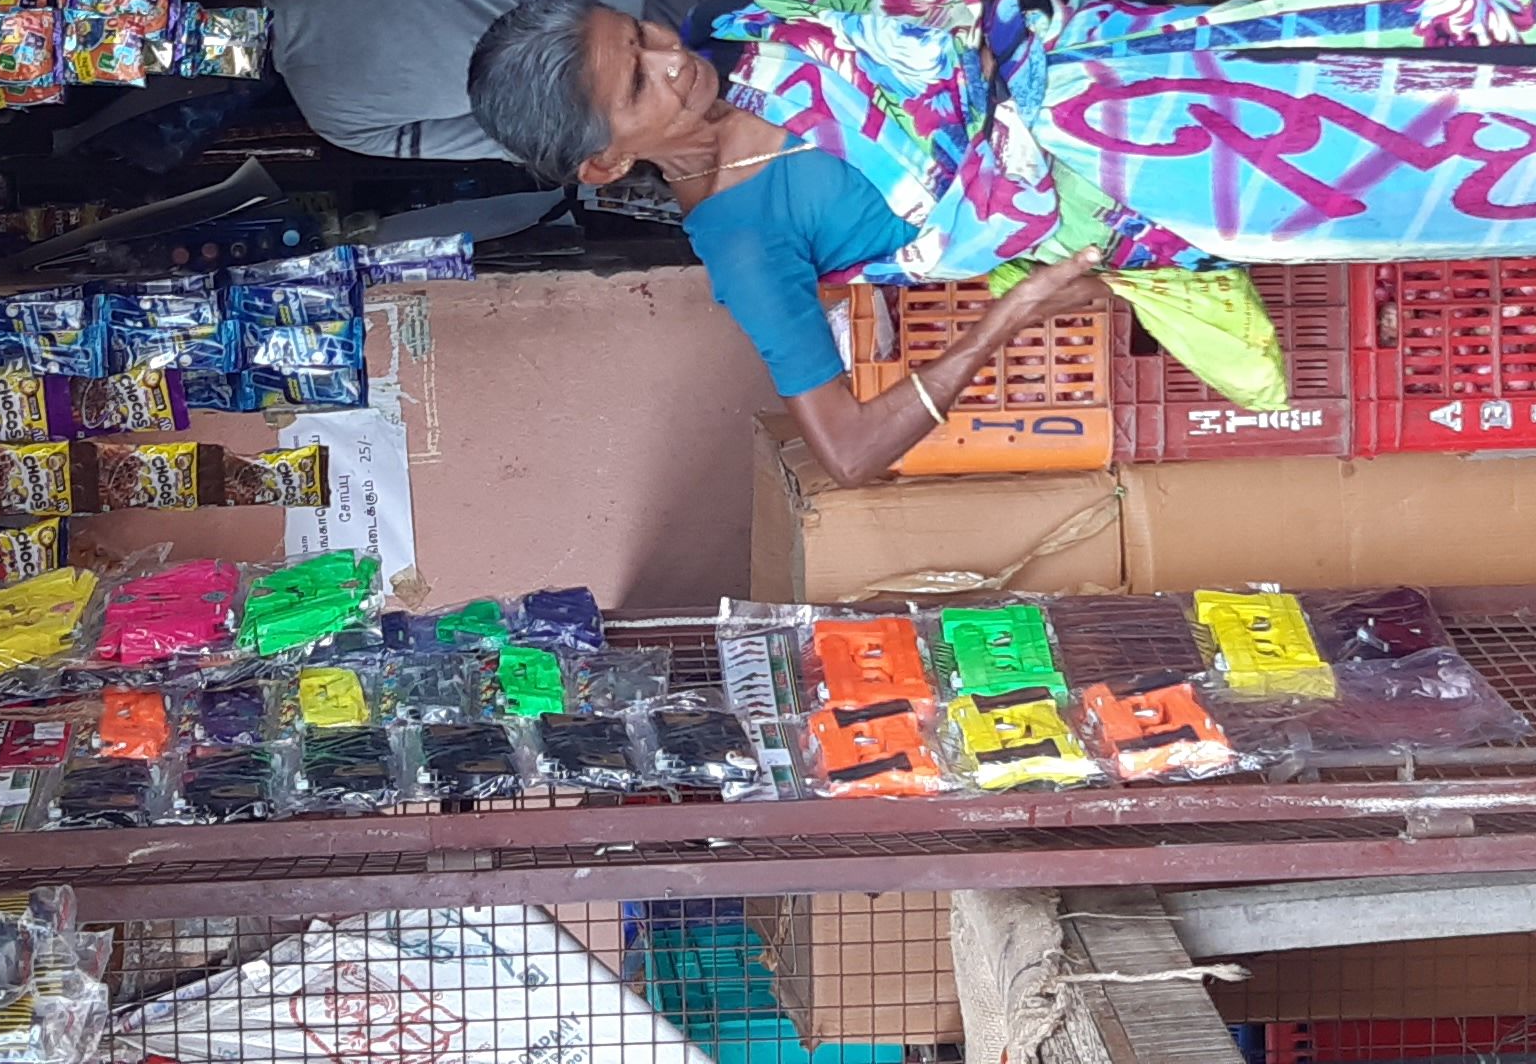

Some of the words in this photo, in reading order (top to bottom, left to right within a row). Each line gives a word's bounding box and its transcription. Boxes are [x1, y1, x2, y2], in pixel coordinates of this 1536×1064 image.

[120, 374, 148, 428] CHOCOS
[22, 455, 46, 509] CHOCOS
[151, 455, 175, 505] CHOCOS
[276, 463, 297, 505] CHOCOS
[336, 475, 352, 522] சோப்பு
[16, 532, 35, 577] CHOC
